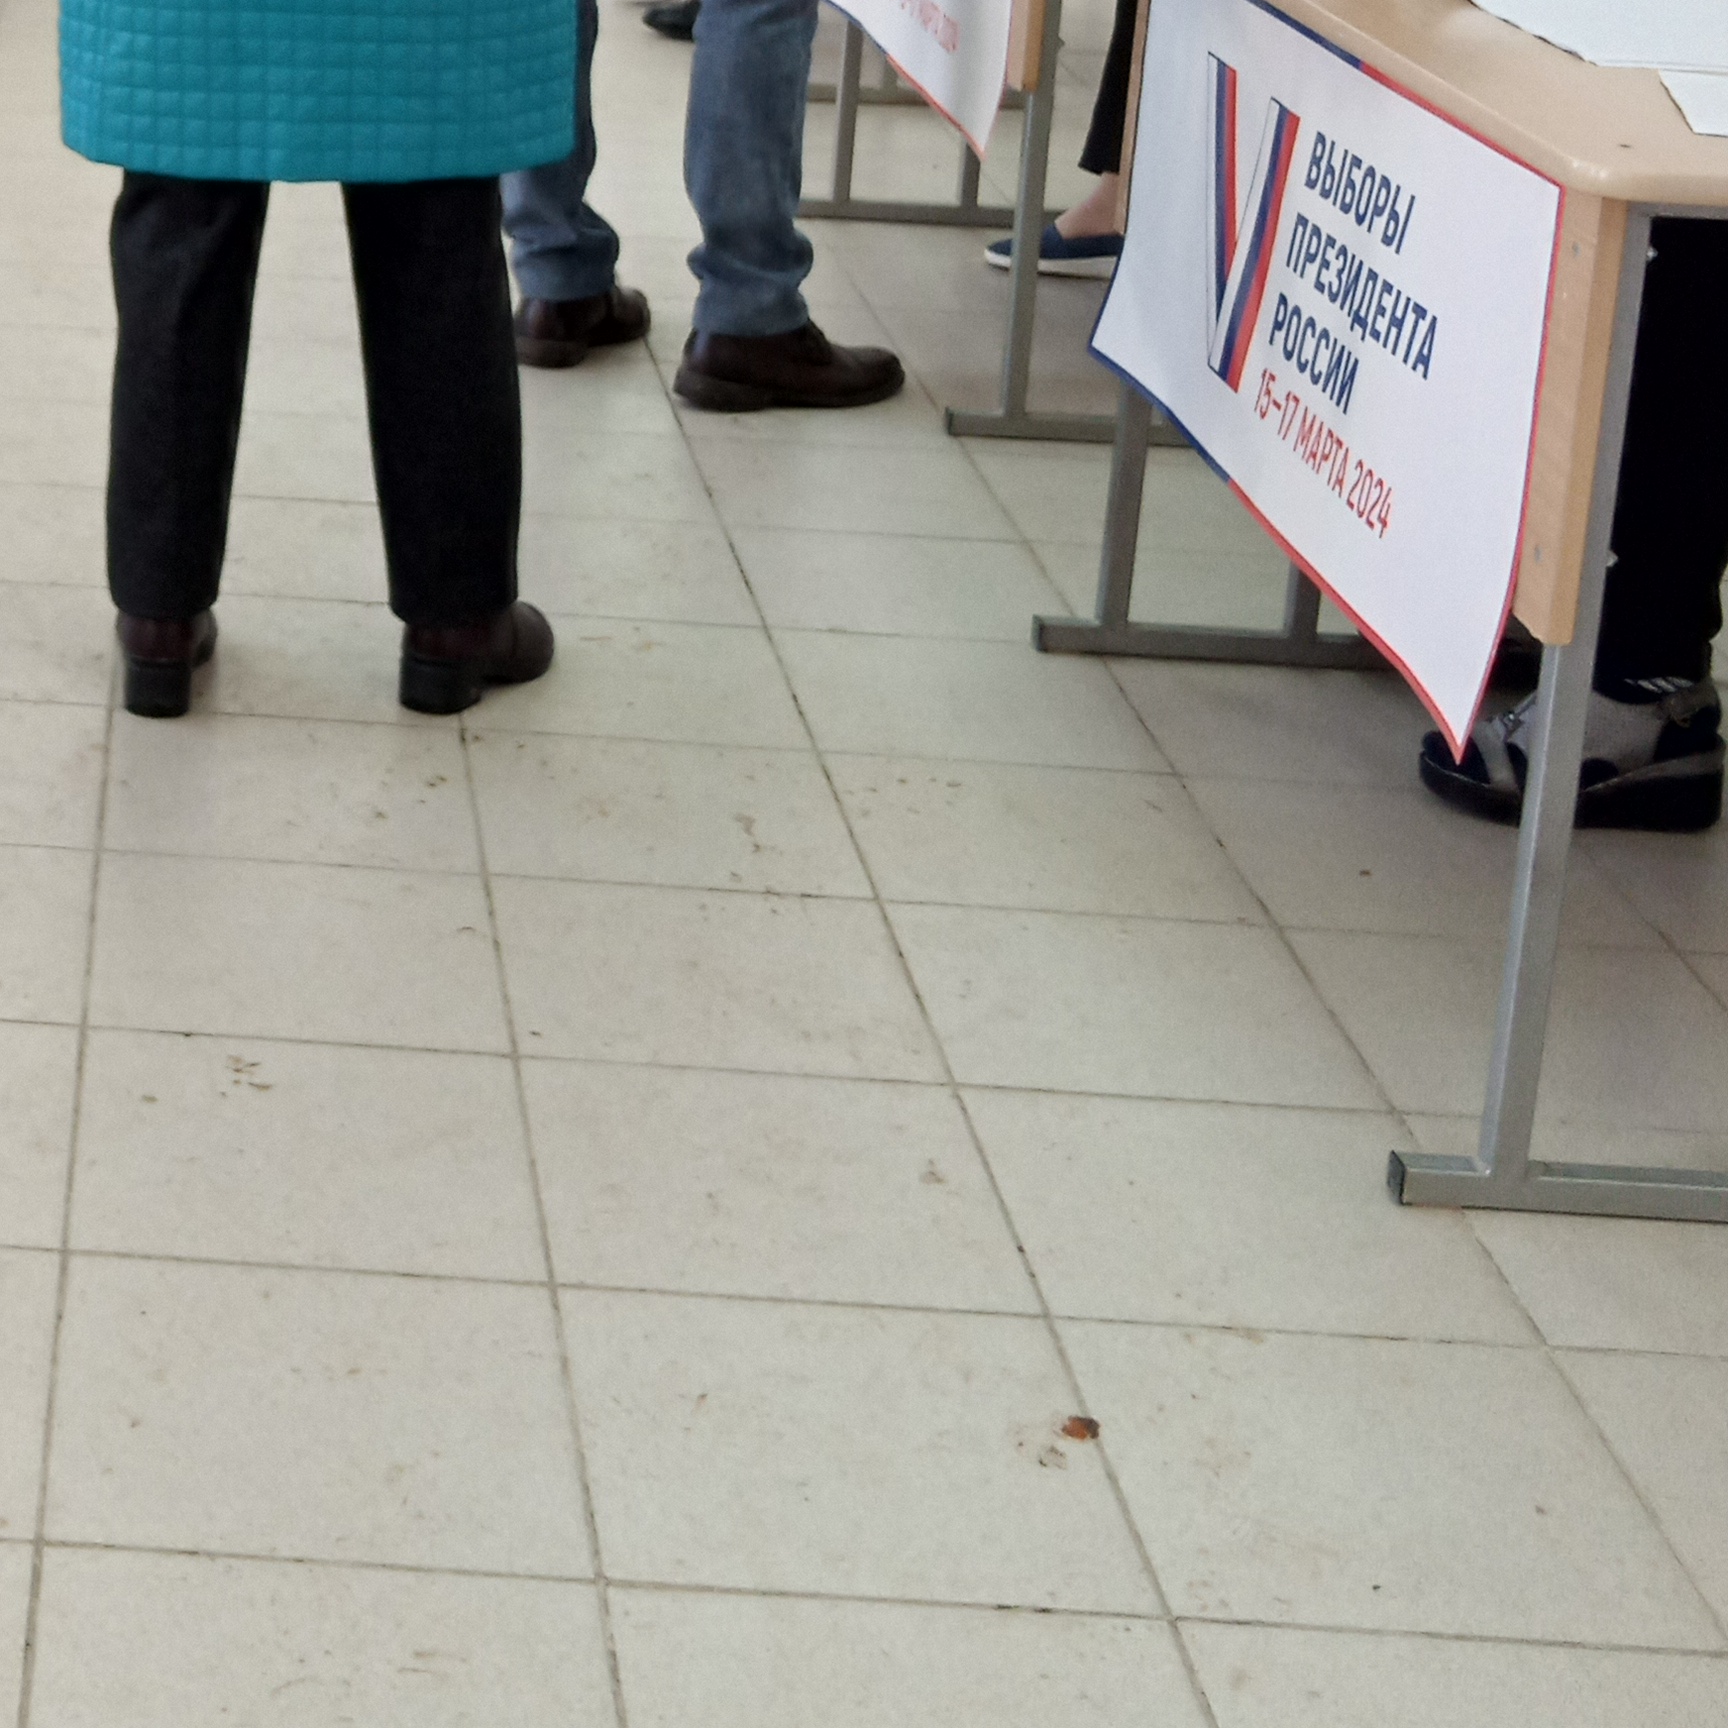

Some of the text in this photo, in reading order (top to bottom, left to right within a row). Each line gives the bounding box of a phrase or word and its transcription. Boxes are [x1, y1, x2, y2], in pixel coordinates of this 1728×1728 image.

[1304, 130, 1416, 255] ВЫБОРЫ
[1268, 292, 1359, 415] РОССИИ
[1285, 211, 1438, 381] ПРЕЗИДЕНТА
[1293, 406, 1349, 498] МАРТА
[1346, 459, 1392, 539] 2024
